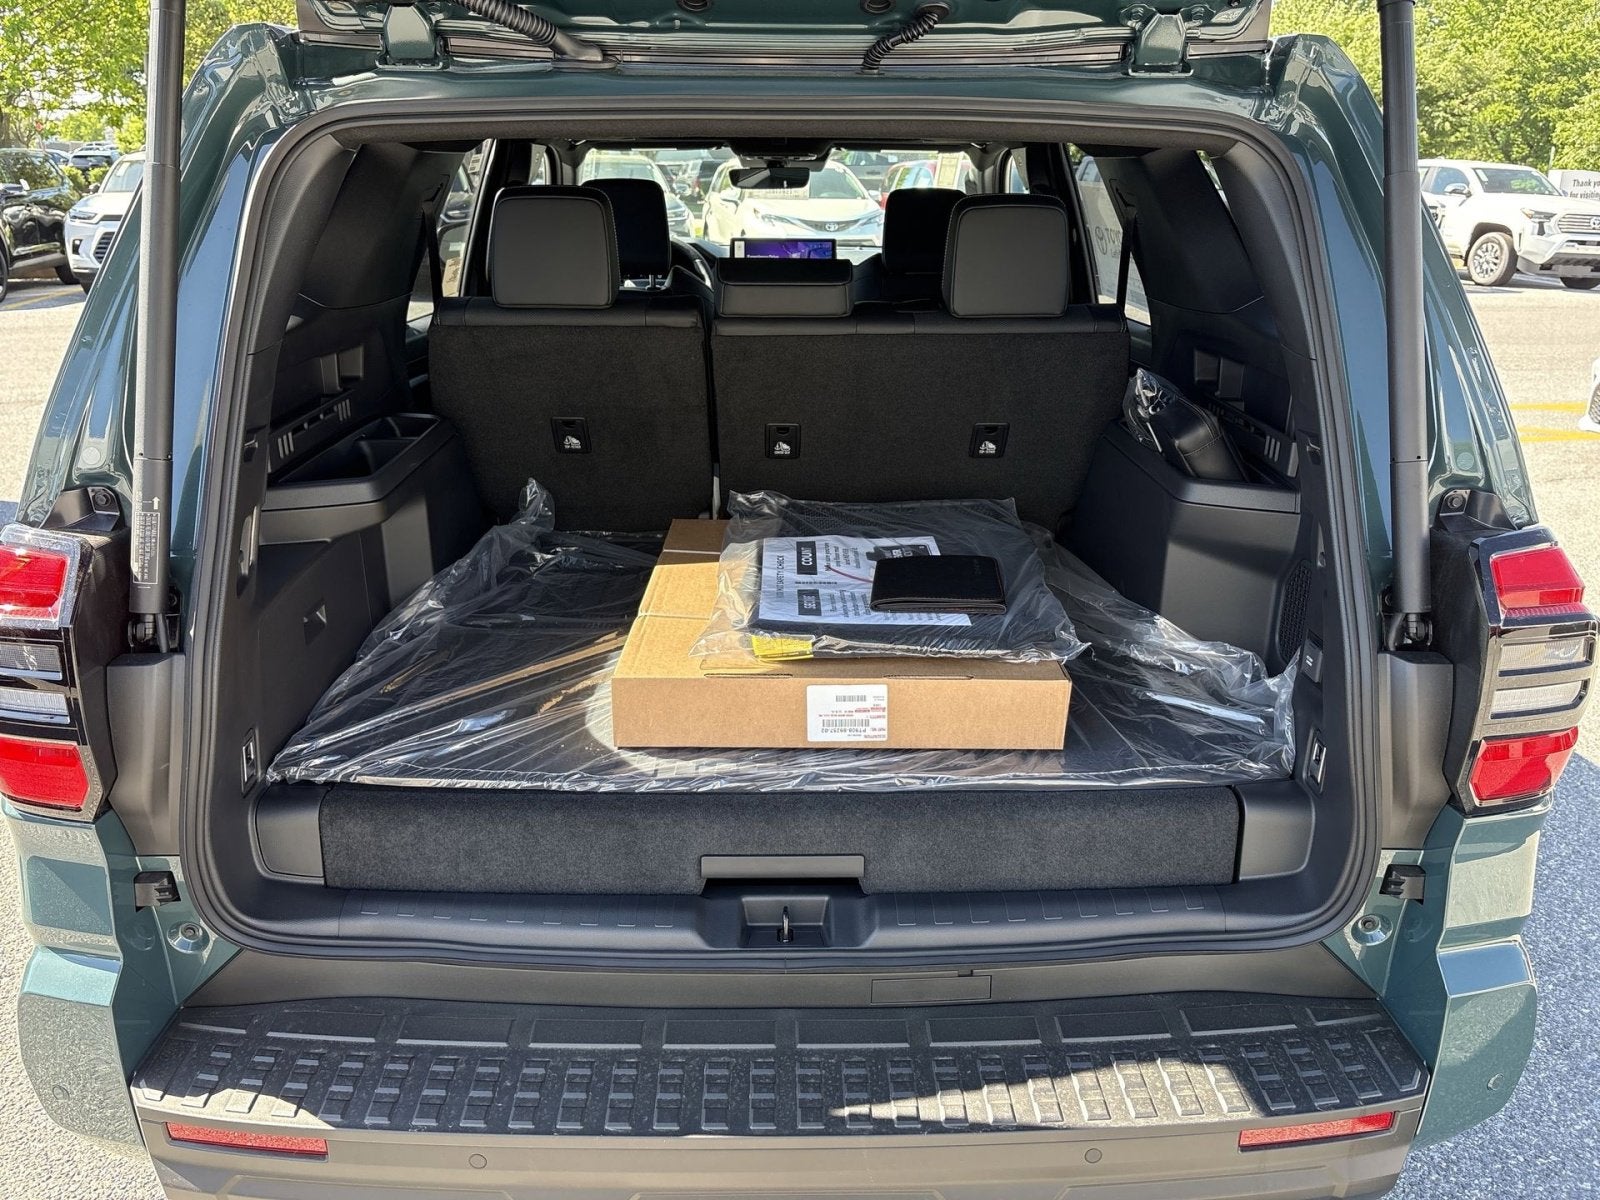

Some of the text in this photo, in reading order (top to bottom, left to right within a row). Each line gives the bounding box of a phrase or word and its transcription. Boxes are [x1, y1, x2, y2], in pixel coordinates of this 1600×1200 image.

[1572, 178, 1592, 187] Thank
[1569, 190, 1579, 198] for
[776, 555, 784, 570] CHECK
[801, 547, 813, 566] COUNT
